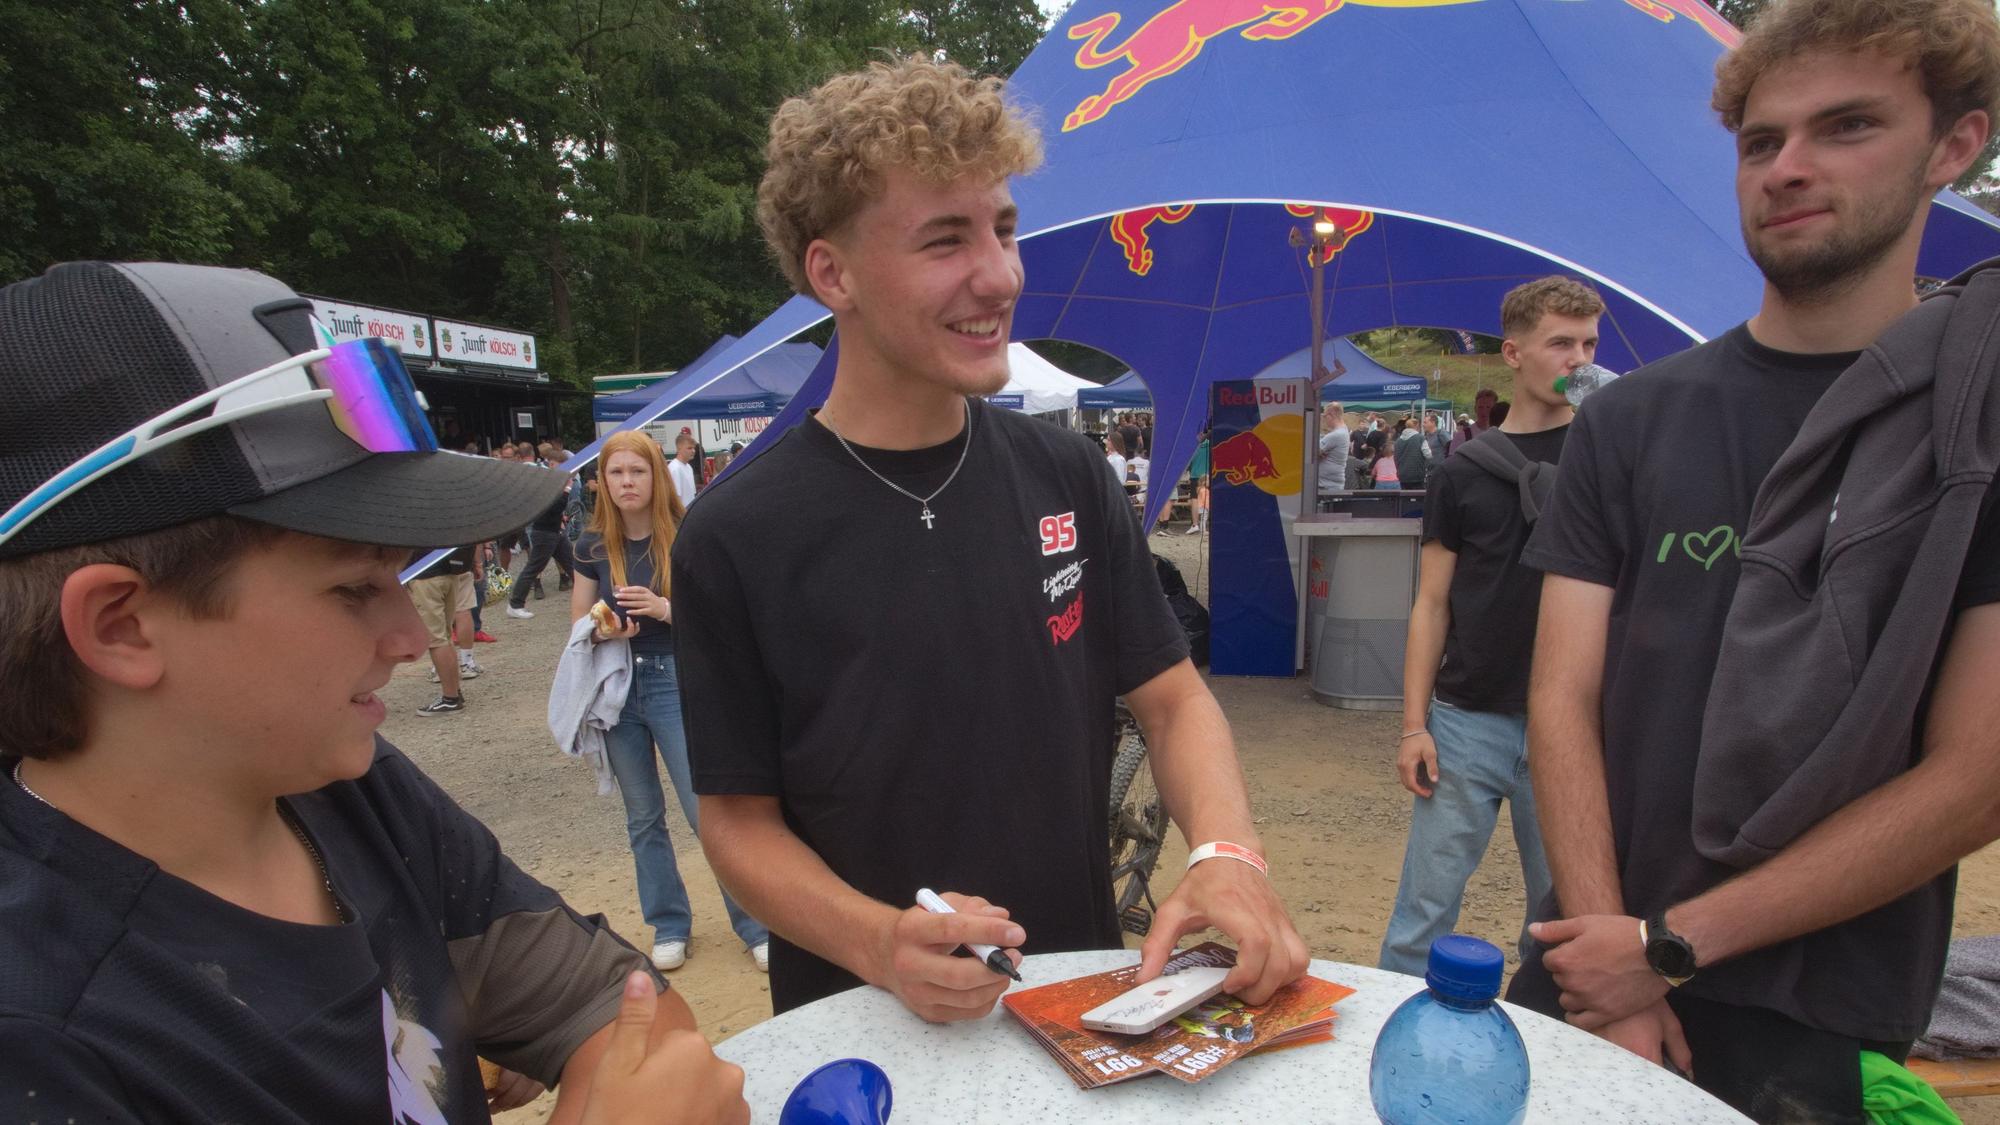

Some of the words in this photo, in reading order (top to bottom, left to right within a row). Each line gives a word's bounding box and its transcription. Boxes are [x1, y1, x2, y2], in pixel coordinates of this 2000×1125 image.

[367, 319, 404, 341] KÖLSCH
[489, 338, 517, 357] KÖLSCH
[1220, 386, 1257, 406] Red
[1260, 385, 1297, 405] Bull
[1040, 511, 1077, 556] 95
[1657, 532, 1677, 563] I
